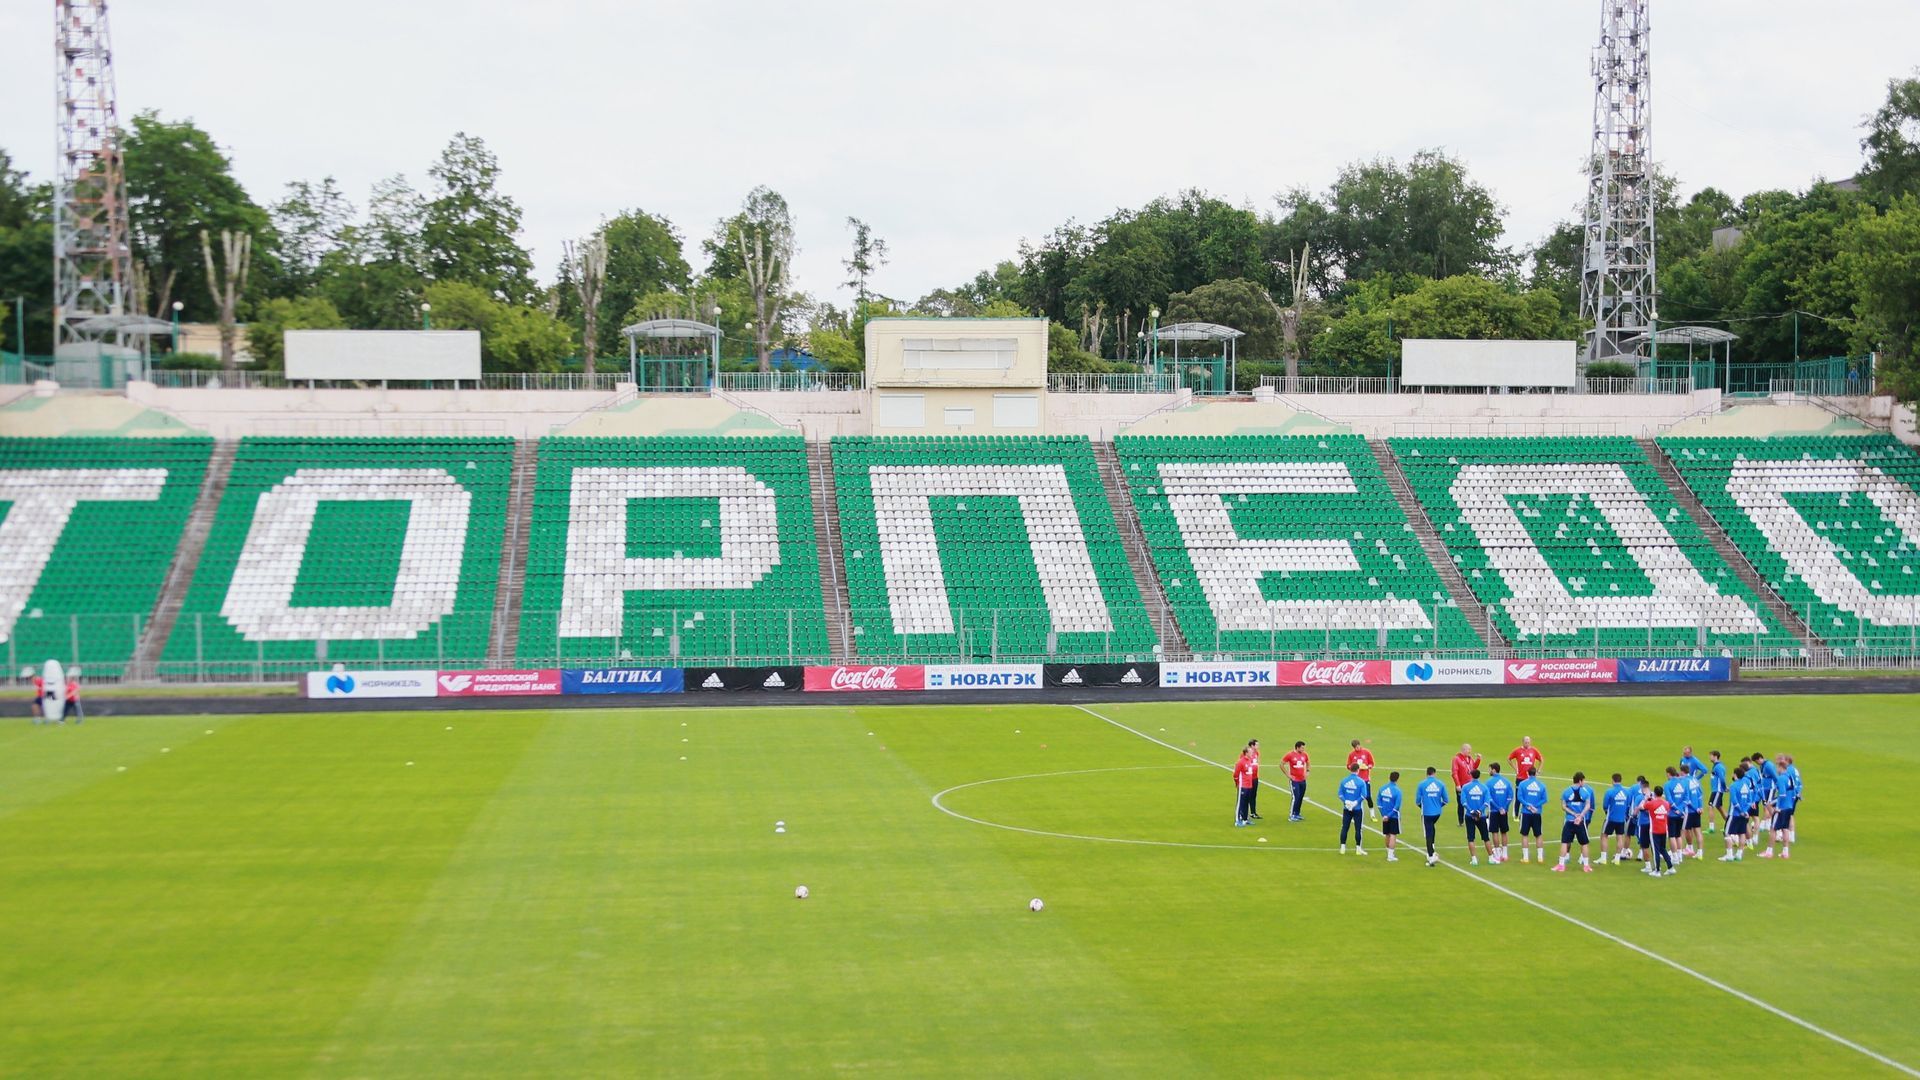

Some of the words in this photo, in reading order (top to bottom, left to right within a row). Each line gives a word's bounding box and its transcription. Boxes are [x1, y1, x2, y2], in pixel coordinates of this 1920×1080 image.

[1541, 662, 1598, 670] МОСКОВСКИЙ
[1636, 659, 1710, 672] БАЛТИКА
[475, 672, 539, 682] МОСКОВСКИЙ
[582, 670, 663, 684] БАЛТИКА
[830, 666, 898, 689] Coca-Cola
[1185, 670, 1271, 683] НОВАТЭК
[1302, 661, 1366, 684] Coca-Cola
[1538, 670, 1590, 679] КРЕДИТНЫЙ
[1591, 671, 1613, 679] БАНК
[950, 673, 1036, 686] НОВАТЭК
[473, 682, 531, 692] КРЕДИТНЫЙ
[531, 683, 556, 691] БАНК
